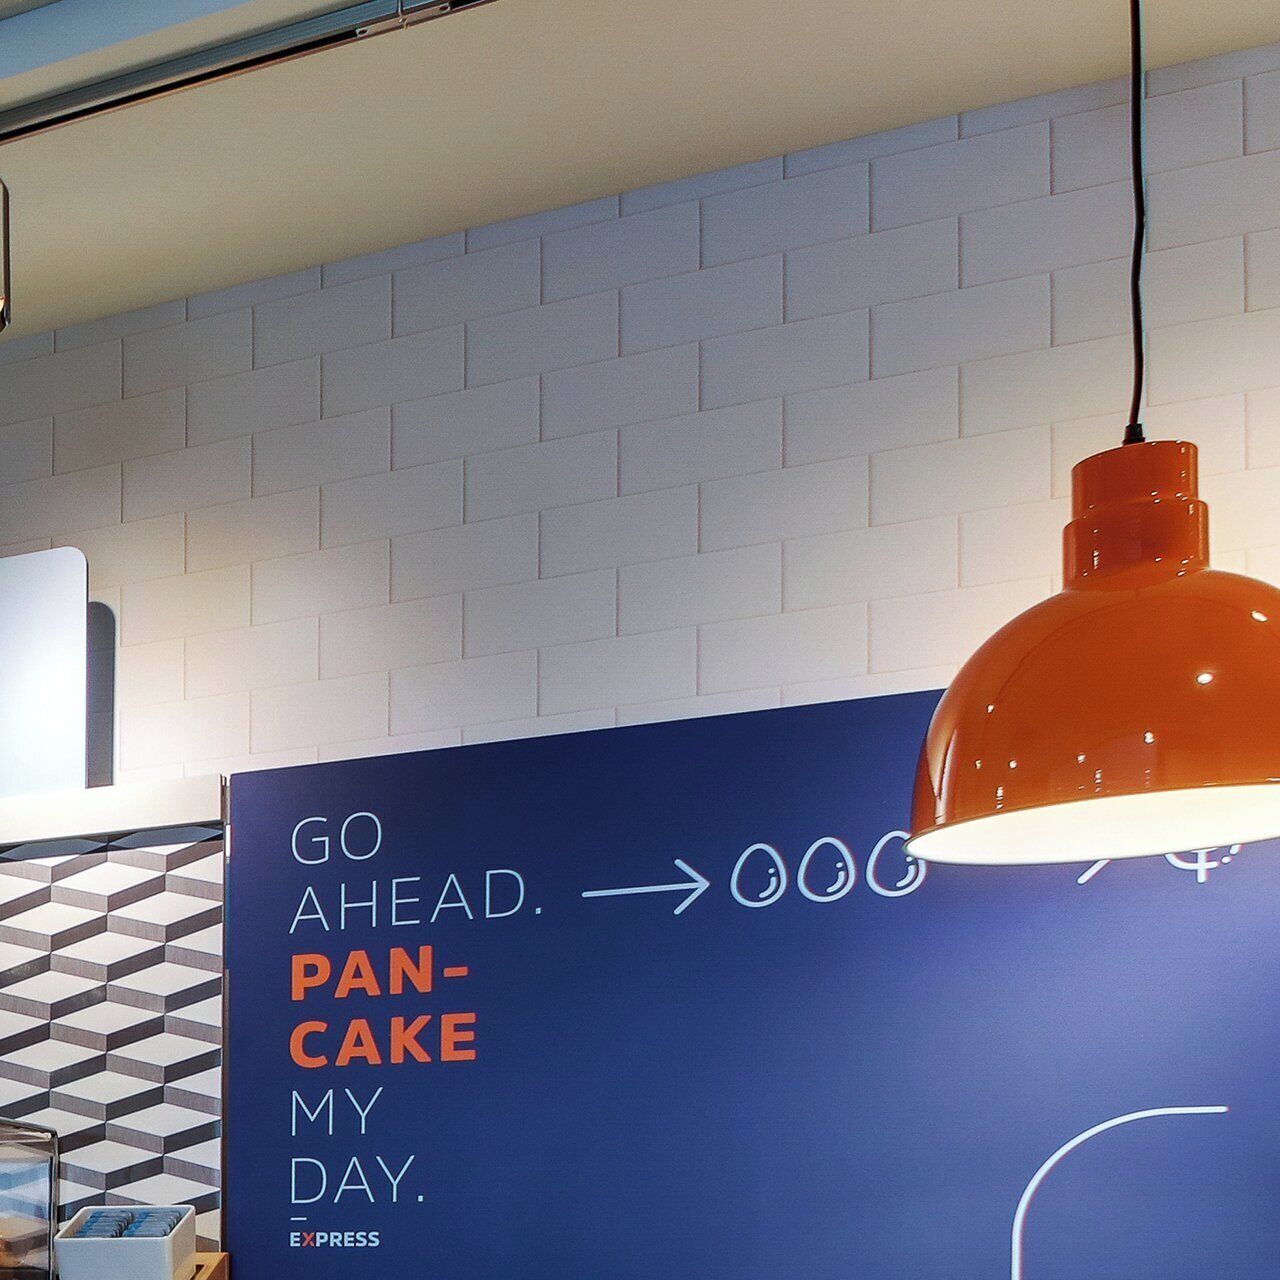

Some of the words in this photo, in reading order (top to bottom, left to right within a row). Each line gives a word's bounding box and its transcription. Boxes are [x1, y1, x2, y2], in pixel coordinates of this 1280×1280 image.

[291, 811, 382, 865] GO
[288, 868, 542, 935] AHEAD.
[291, 945, 468, 1001] PAN-
[289, 1012, 476, 1069] CAKE
[291, 1086, 383, 1136] MY
[291, 1155, 424, 1204] DAY.
[290, 1232, 380, 1247] EXPRESS
